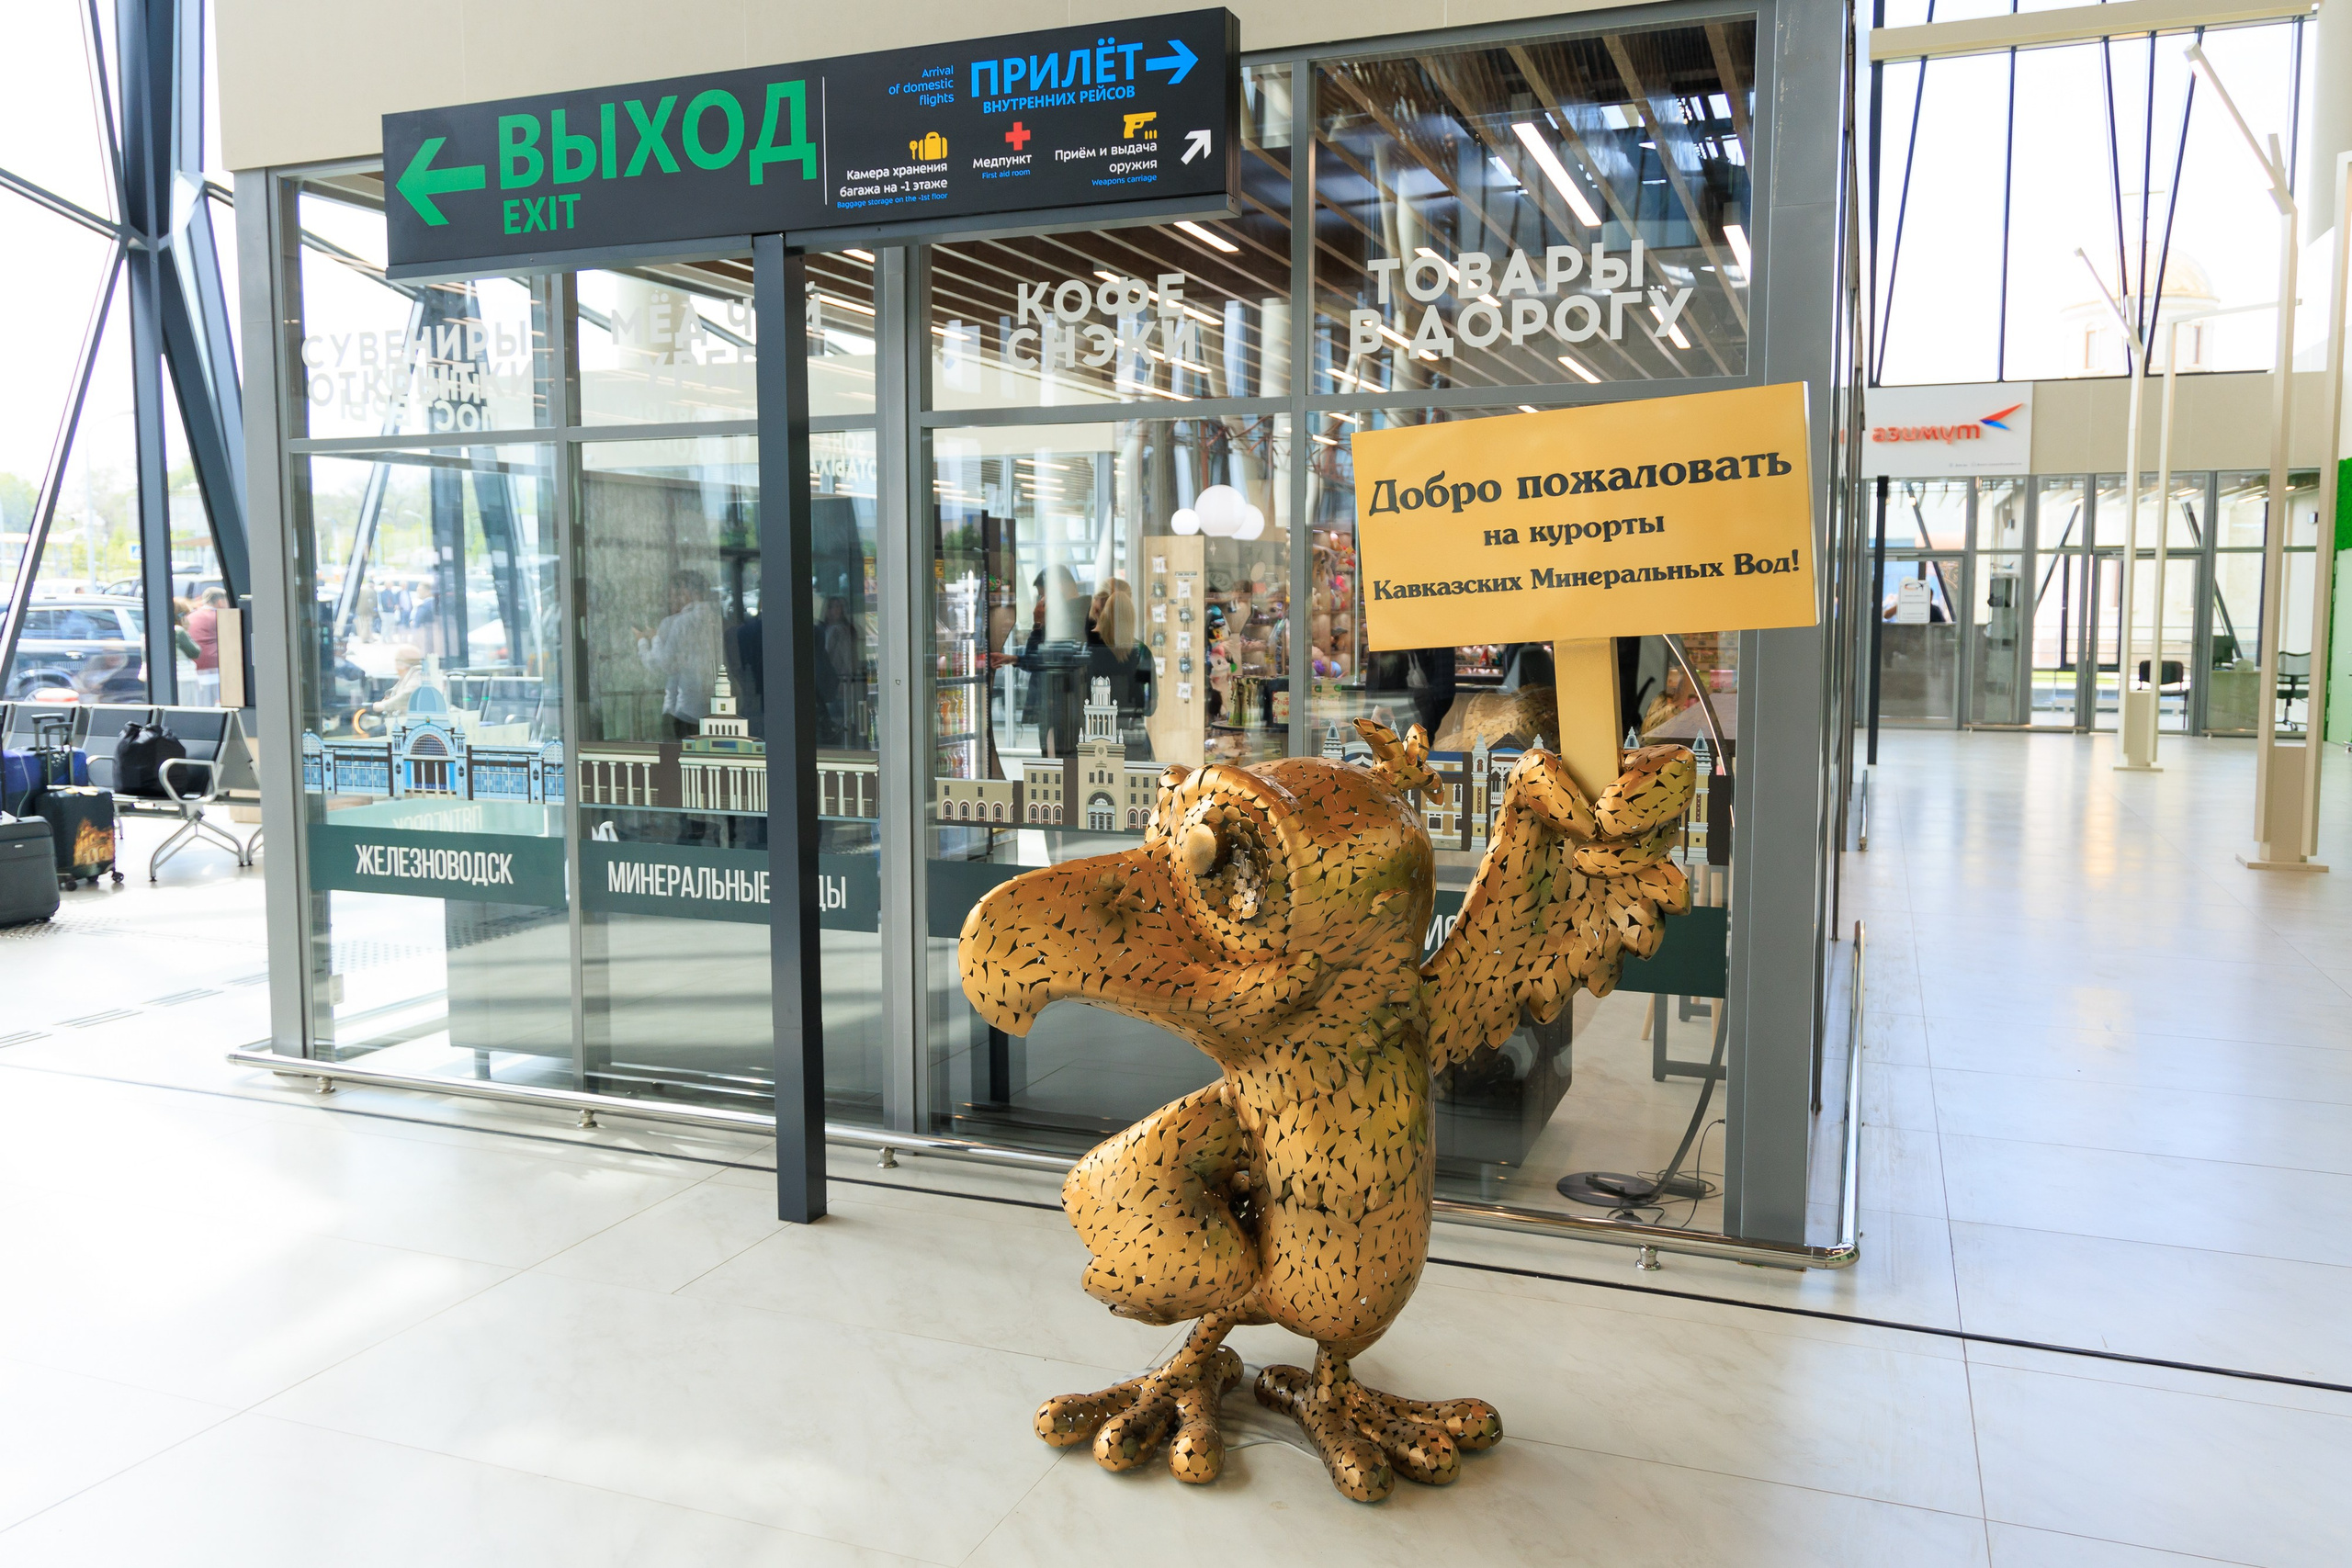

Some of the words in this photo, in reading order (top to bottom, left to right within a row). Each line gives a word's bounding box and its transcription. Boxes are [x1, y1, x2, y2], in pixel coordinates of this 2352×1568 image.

[922, 64, 954, 78] Arrival
[970, 37, 1143, 97] ПРИЛЁТ
[888, 84, 900, 96] of
[903, 77, 954, 94] domestic
[919, 92, 955, 107] flights
[983, 91, 1076, 114] ВНУТРЕННИХ
[1080, 85, 1136, 103] РЕЙСОВ
[498, 79, 817, 189] ВЫХОД
[1055, 146, 1096, 162] Приём
[1100, 148, 1107, 157] и
[1111, 141, 1158, 156] выдача
[846, 167, 890, 180] Камера
[892, 163, 947, 178] хранения
[972, 153, 1033, 169] Медпункт
[981, 171, 998, 179] First
[999, 170, 1011, 178] aid
[1012, 168, 1031, 176] room
[1109, 159, 1158, 175] оружия
[840, 185, 880, 197] багажа
[884, 183, 898, 193] на
[900, 181, 910, 191] -1
[912, 179, 948, 191] этаже
[1091, 177, 1125, 186] Weapons
[1126, 174, 1158, 184] carriage
[503, 193, 581, 235] EXIT
[837, 199, 866, 209] Baggage
[867, 197, 893, 206] storage
[932, 192, 948, 200] floor
[1367, 239, 1645, 305] ТОВАРЫ
[1017, 273, 1186, 326] КОФЕ
[611, 291, 707, 349] МЁД
[1350, 308, 1382, 355] В
[1408, 286, 1694, 361] ДОРОГУ
[301, 320, 527, 369] СУВЕНИРЫ
[1006, 318, 1197, 370] СНЭКИ
[308, 360, 534, 406] ОТКРЫТКИ
[1871, 423, 1981, 445] азимут
[1368, 470, 1501, 516] Добро
[1517, 451, 1792, 500] пожаловать
[1484, 528, 1519, 547] на
[1529, 514, 1665, 547] курорты
[1374, 573, 1523, 600] Кавказских
[1531, 558, 1724, 590] Минеральных
[1734, 548, 1800, 575] Вод!
[355, 844, 514, 886] ЖЕЛЕЗНОВОДСК
[607, 861, 771, 904] МИНЕРАЛЬНЫЕ
